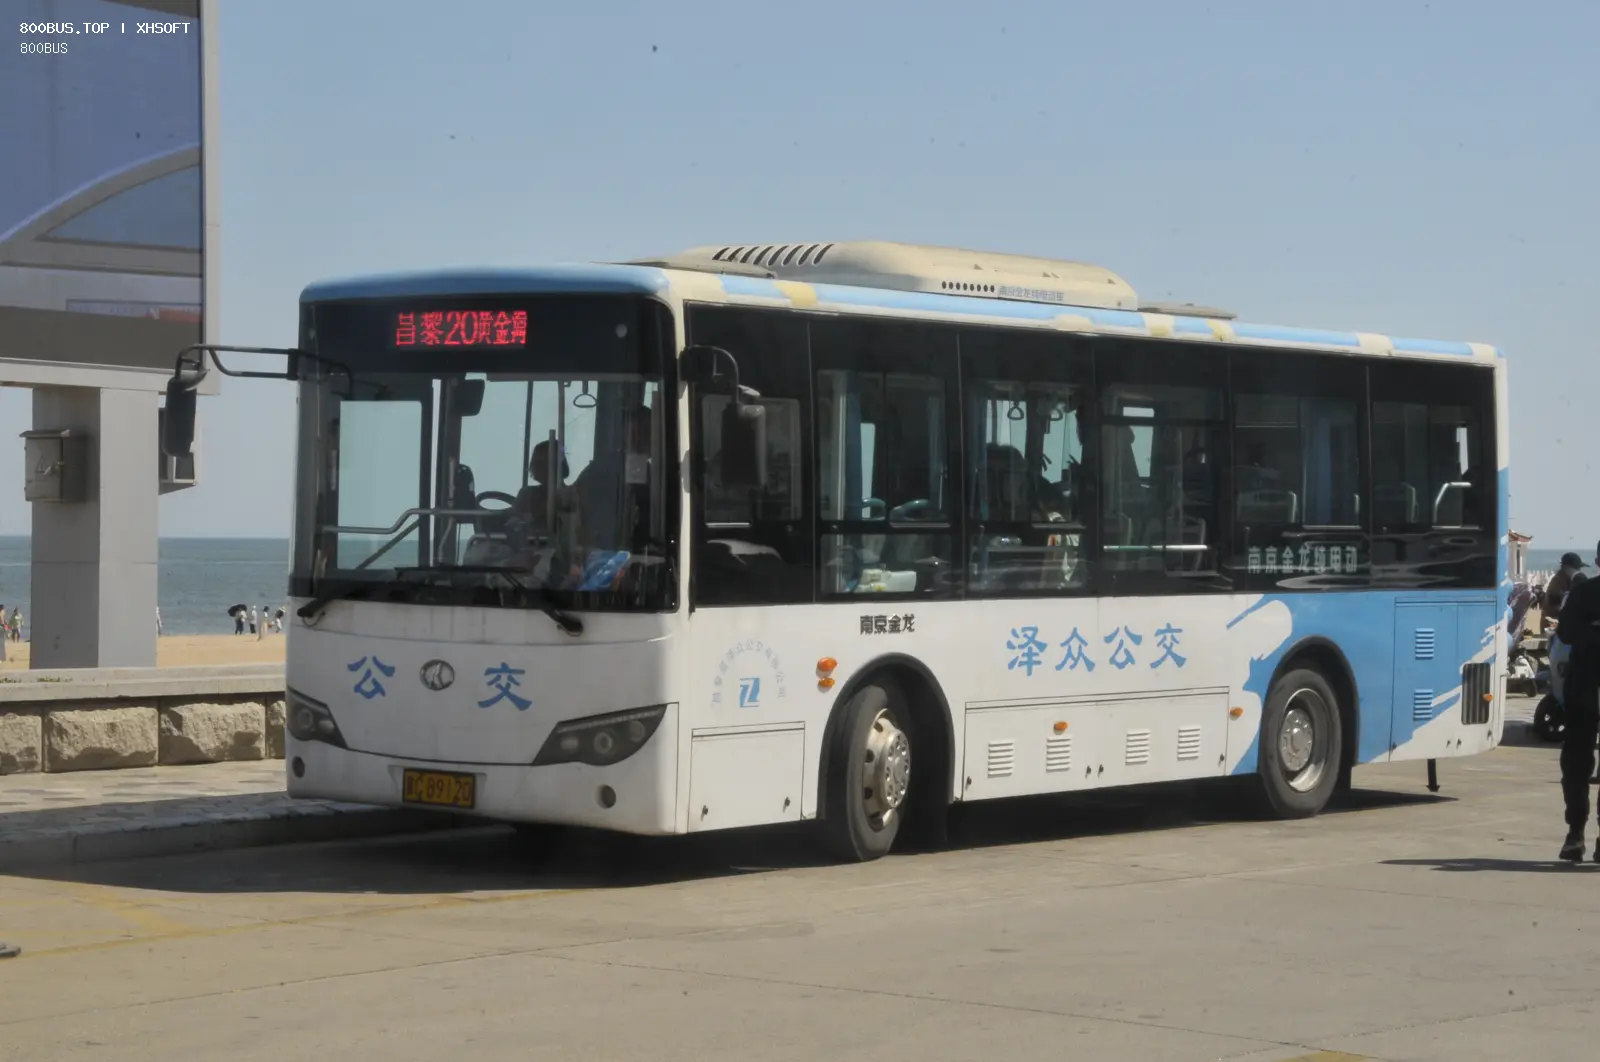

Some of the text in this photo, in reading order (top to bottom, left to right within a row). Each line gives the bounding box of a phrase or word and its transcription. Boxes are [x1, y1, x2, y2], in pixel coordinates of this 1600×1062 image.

[859, 613, 916, 635] 南京金龙
[1006, 622, 1188, 677] 泽众公交
